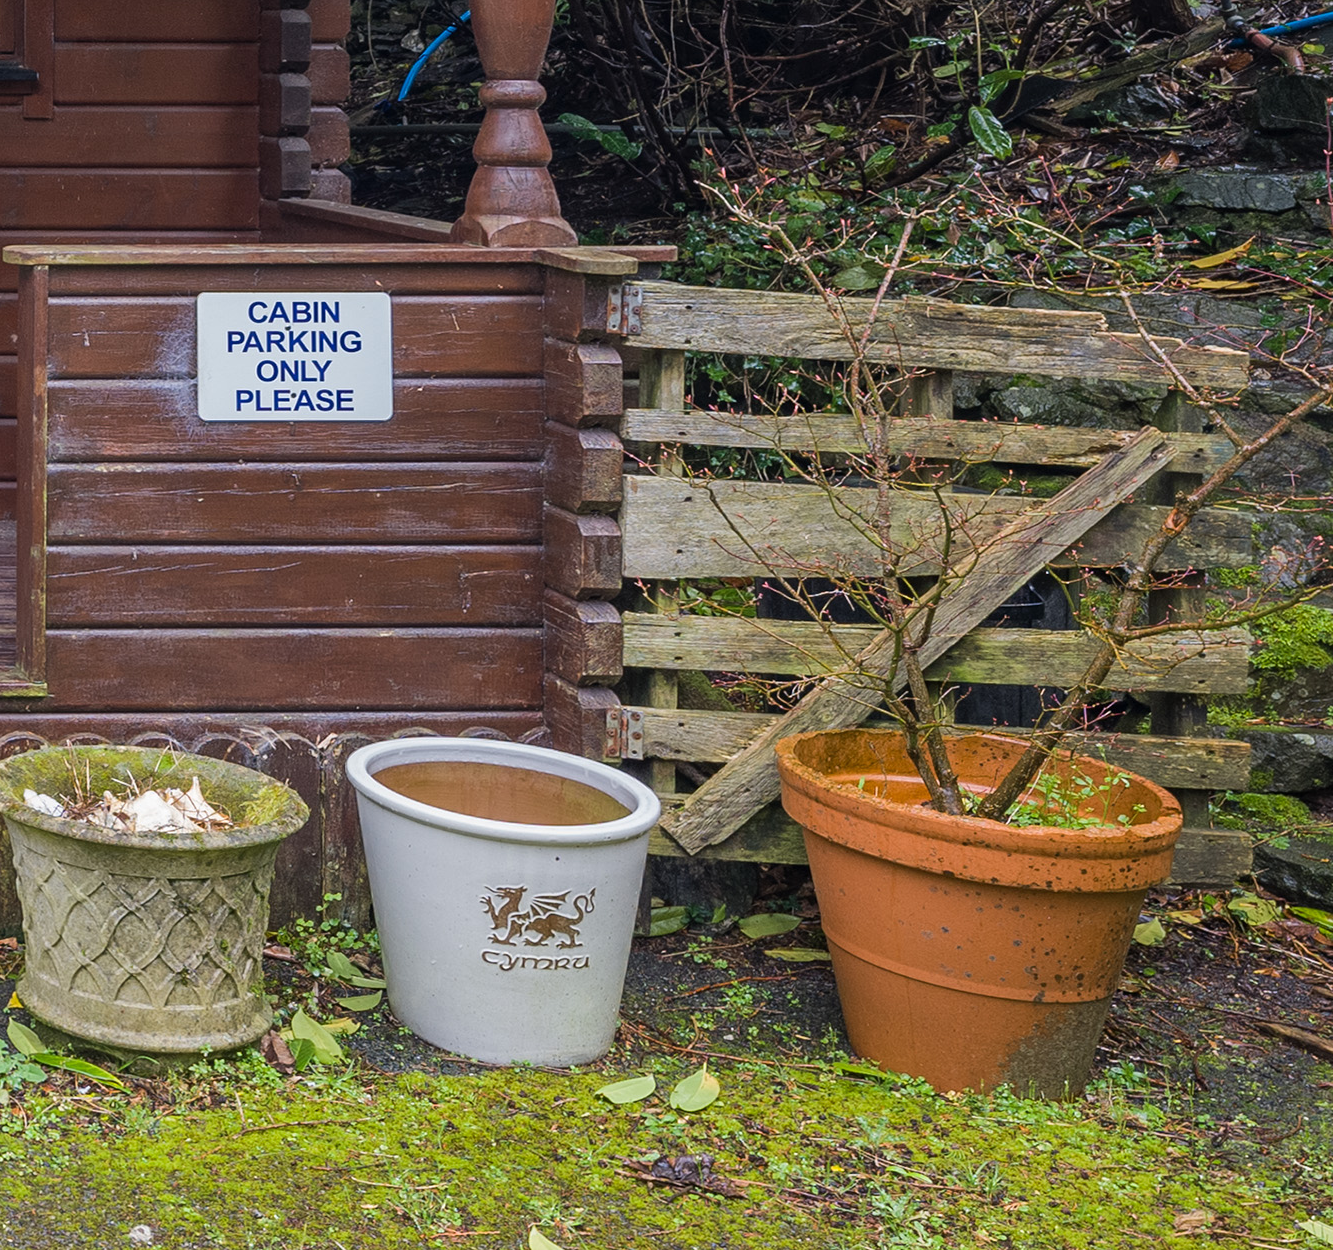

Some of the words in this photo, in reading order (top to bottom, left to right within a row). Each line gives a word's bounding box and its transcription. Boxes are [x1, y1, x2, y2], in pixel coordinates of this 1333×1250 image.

[247, 301, 340, 324] CABIN
[227, 330, 362, 353] PARKING
[256, 360, 333, 382] ONLY
[235, 389, 355, 412] PLEASE
